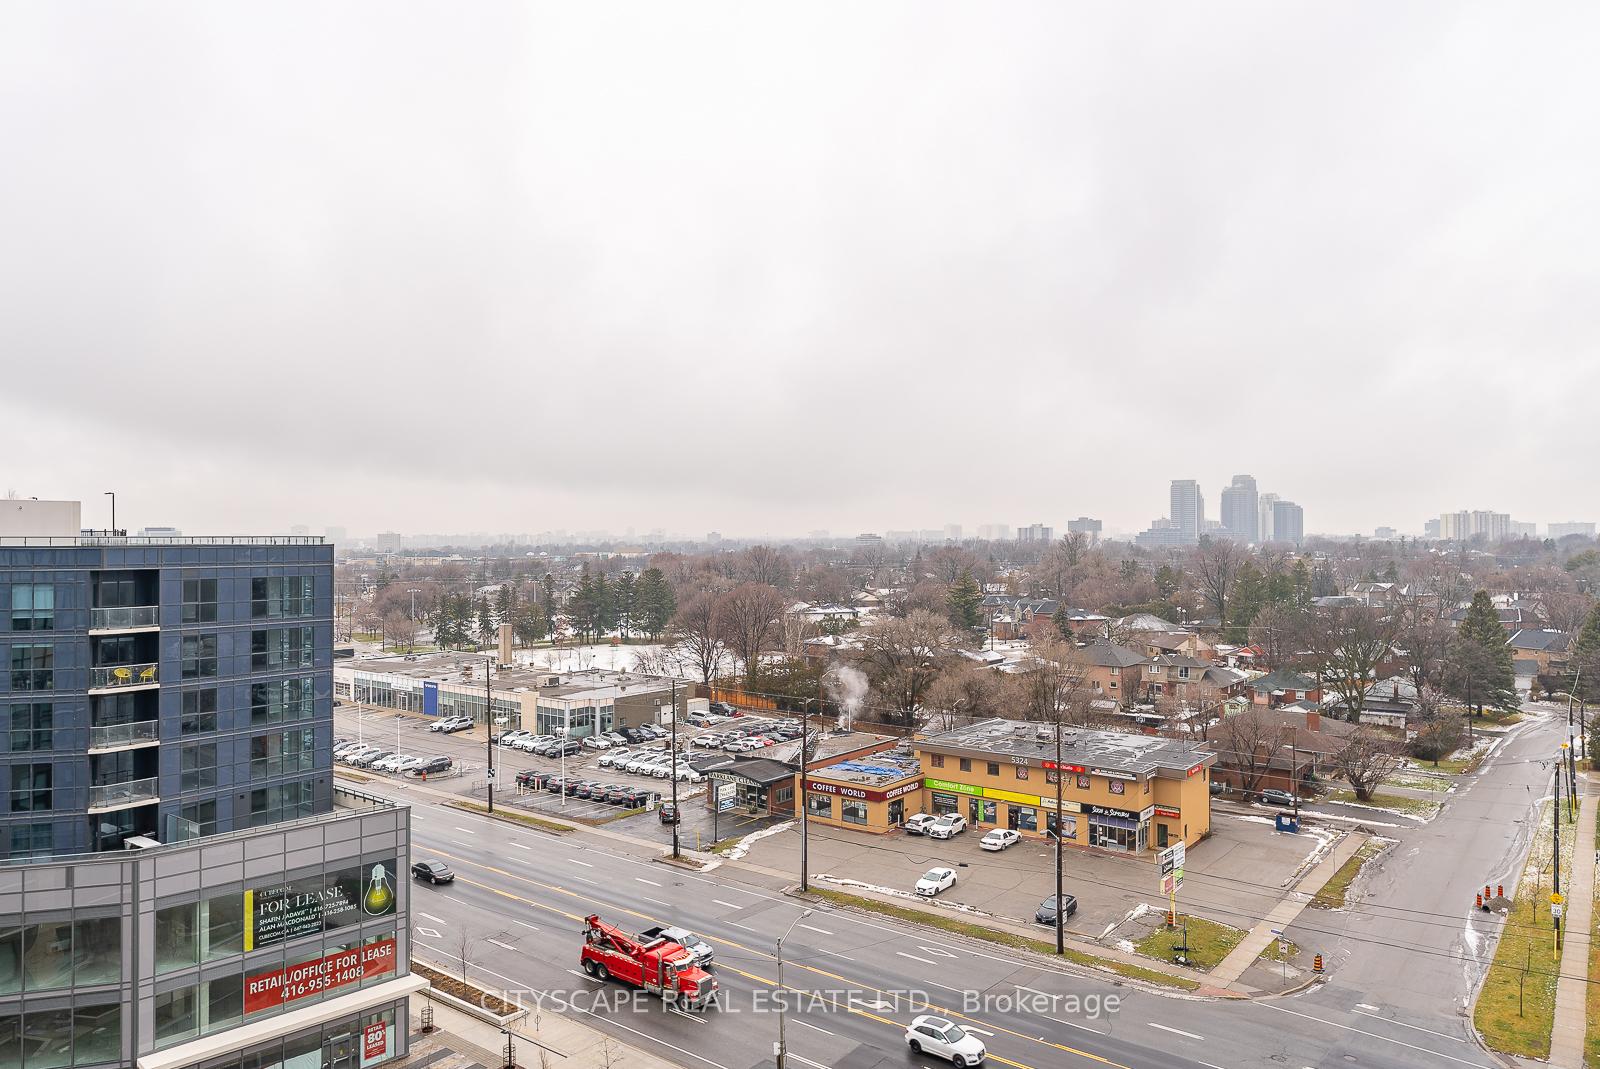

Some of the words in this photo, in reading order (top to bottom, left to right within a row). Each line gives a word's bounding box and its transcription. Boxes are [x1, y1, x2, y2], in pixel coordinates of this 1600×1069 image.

[1011, 756, 1028, 765] 5324
[812, 782, 837, 794] COFFEE
[840, 787, 866, 799] WORLD
[886, 787, 903, 799] COFFEE
[902, 782, 919, 794] WORLD
[933, 780, 959, 791] Comfort
[959, 783, 975, 793] Zone
[260, 898, 291, 916] FOR
[296, 885, 343, 907] LEASE
[259, 923, 276, 933] ALAN
[249, 960, 333, 995] RETAIL/OFFICE
[336, 953, 357, 971] FOR
[362, 944, 392, 963] LEASE
[280, 965, 364, 999] 416-955-1408
